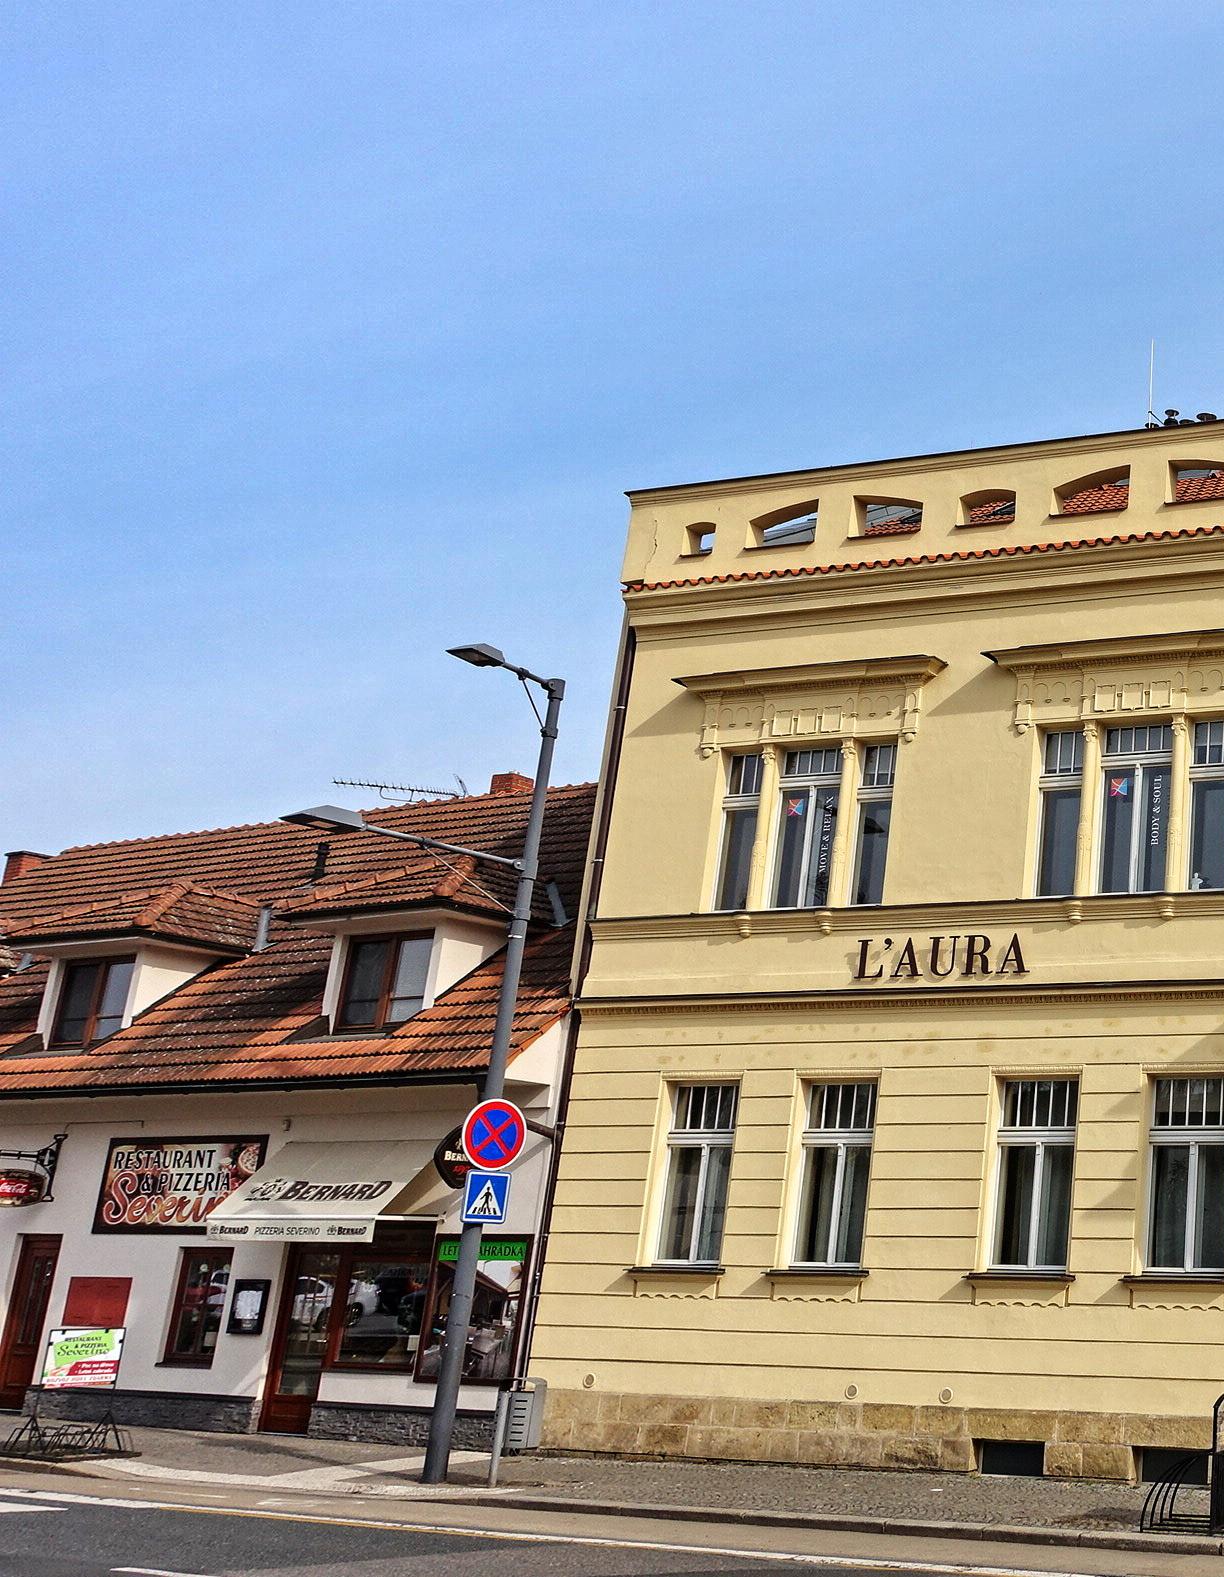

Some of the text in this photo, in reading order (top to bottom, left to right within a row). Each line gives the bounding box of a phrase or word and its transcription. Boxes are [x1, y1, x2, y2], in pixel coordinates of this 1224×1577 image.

[1152, 774, 1163, 804] SOUL
[823, 796, 834, 831] RELAX
[1150, 816, 1160, 845] BODY
[818, 843, 829, 873] MOVE
[113, 1149, 217, 1170] RESTAURANT
[141, 1172, 231, 1193] & PIZZERIA
[279, 1180, 393, 1201] BERNARD
[219, 1225, 249, 1235] BERNARD
[254, 1226, 321, 1236] PIZZERIA SEVERINO
[336, 1226, 367, 1236] BERNARD
[57, 1344, 110, 1356] Severino
